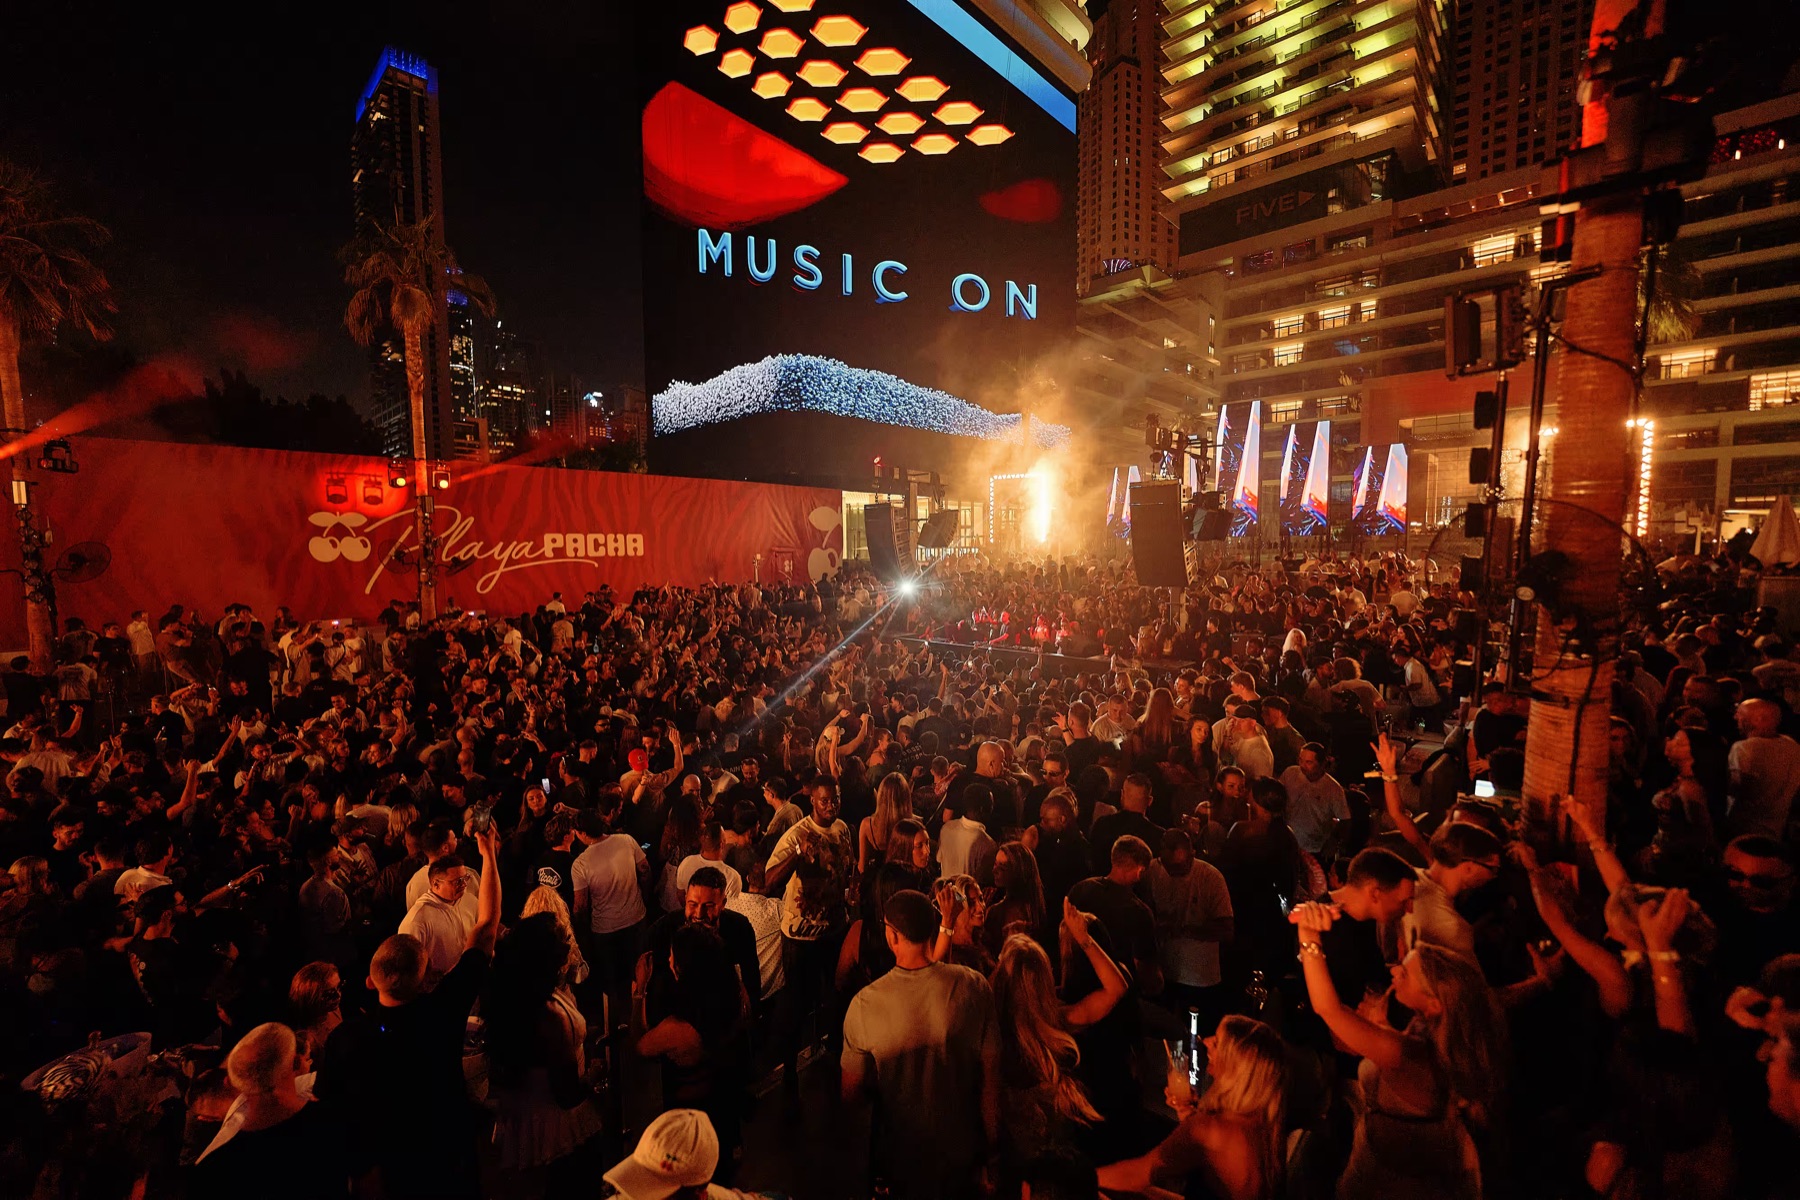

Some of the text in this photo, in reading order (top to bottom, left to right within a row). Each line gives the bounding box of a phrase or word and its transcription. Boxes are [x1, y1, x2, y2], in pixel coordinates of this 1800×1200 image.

[1236, 191, 1295, 225] FIVE
[697, 228, 1038, 321] MUSIC ON
[364, 505, 644, 594] Playa PACHA
